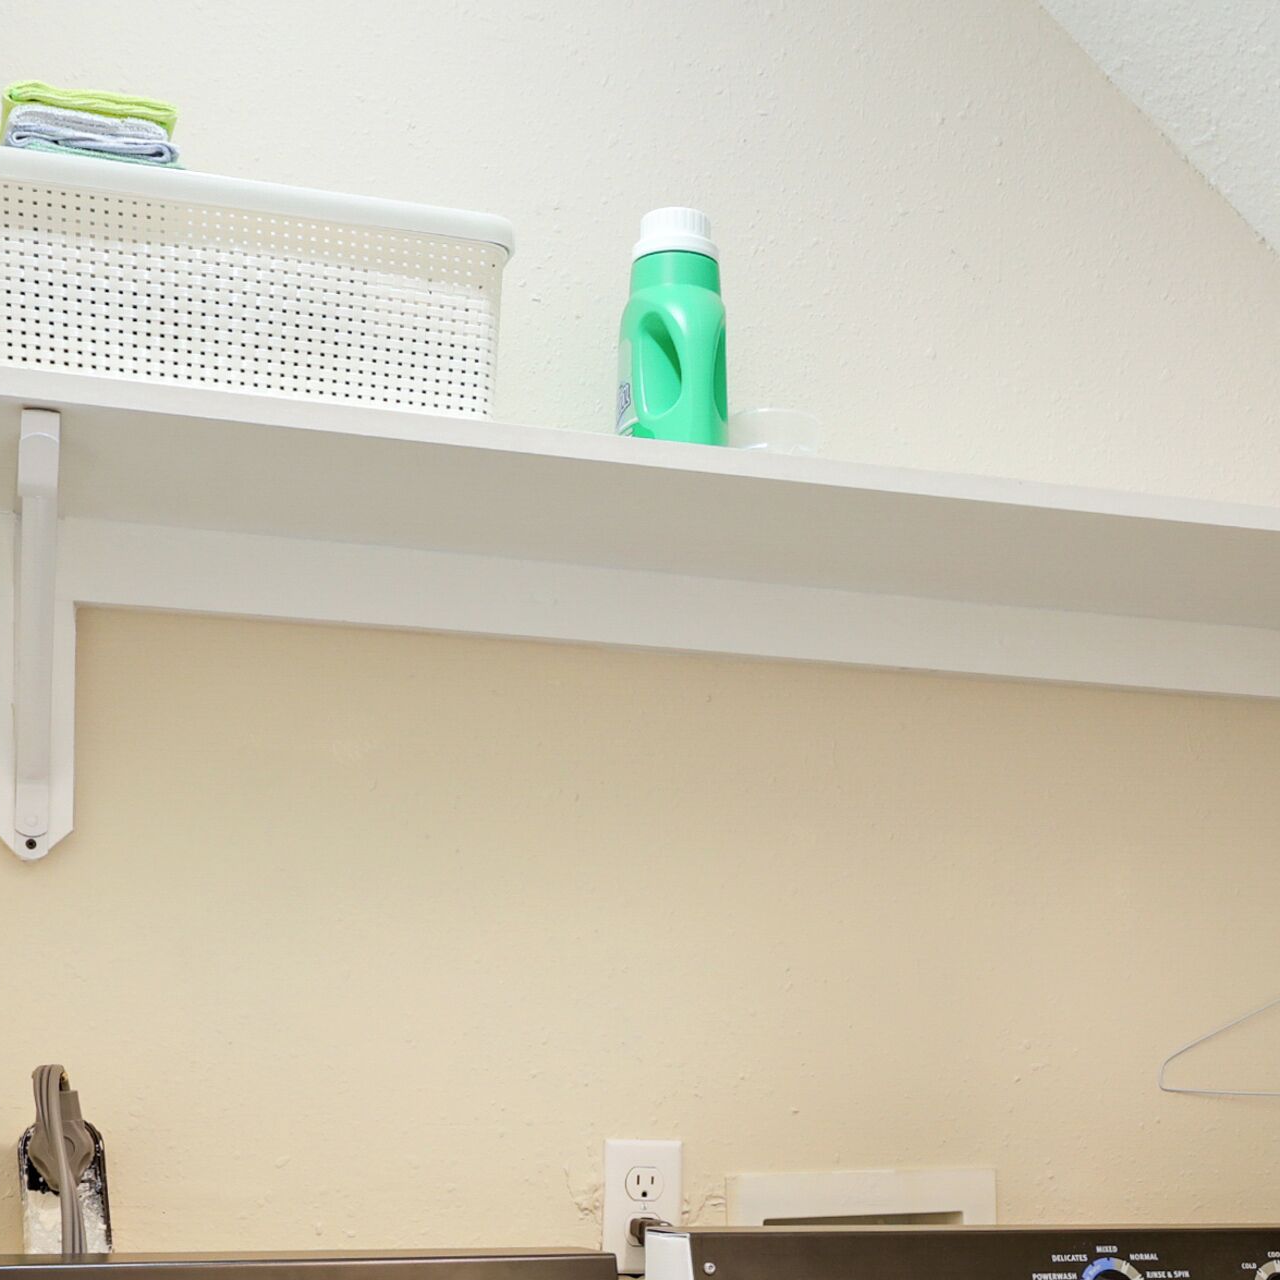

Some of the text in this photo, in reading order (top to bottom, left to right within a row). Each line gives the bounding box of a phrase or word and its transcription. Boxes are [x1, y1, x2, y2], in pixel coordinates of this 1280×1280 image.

[1051, 1254, 1088, 1262] DELICATES
[1130, 1253, 1158, 1261] NORMAL
[1241, 1262, 1257, 1270] COLD
[1032, 1272, 1077, 1280] POWERWASH
[1146, 1271, 1167, 1279] RINSE
[1174, 1270, 1189, 1278] SPIN
